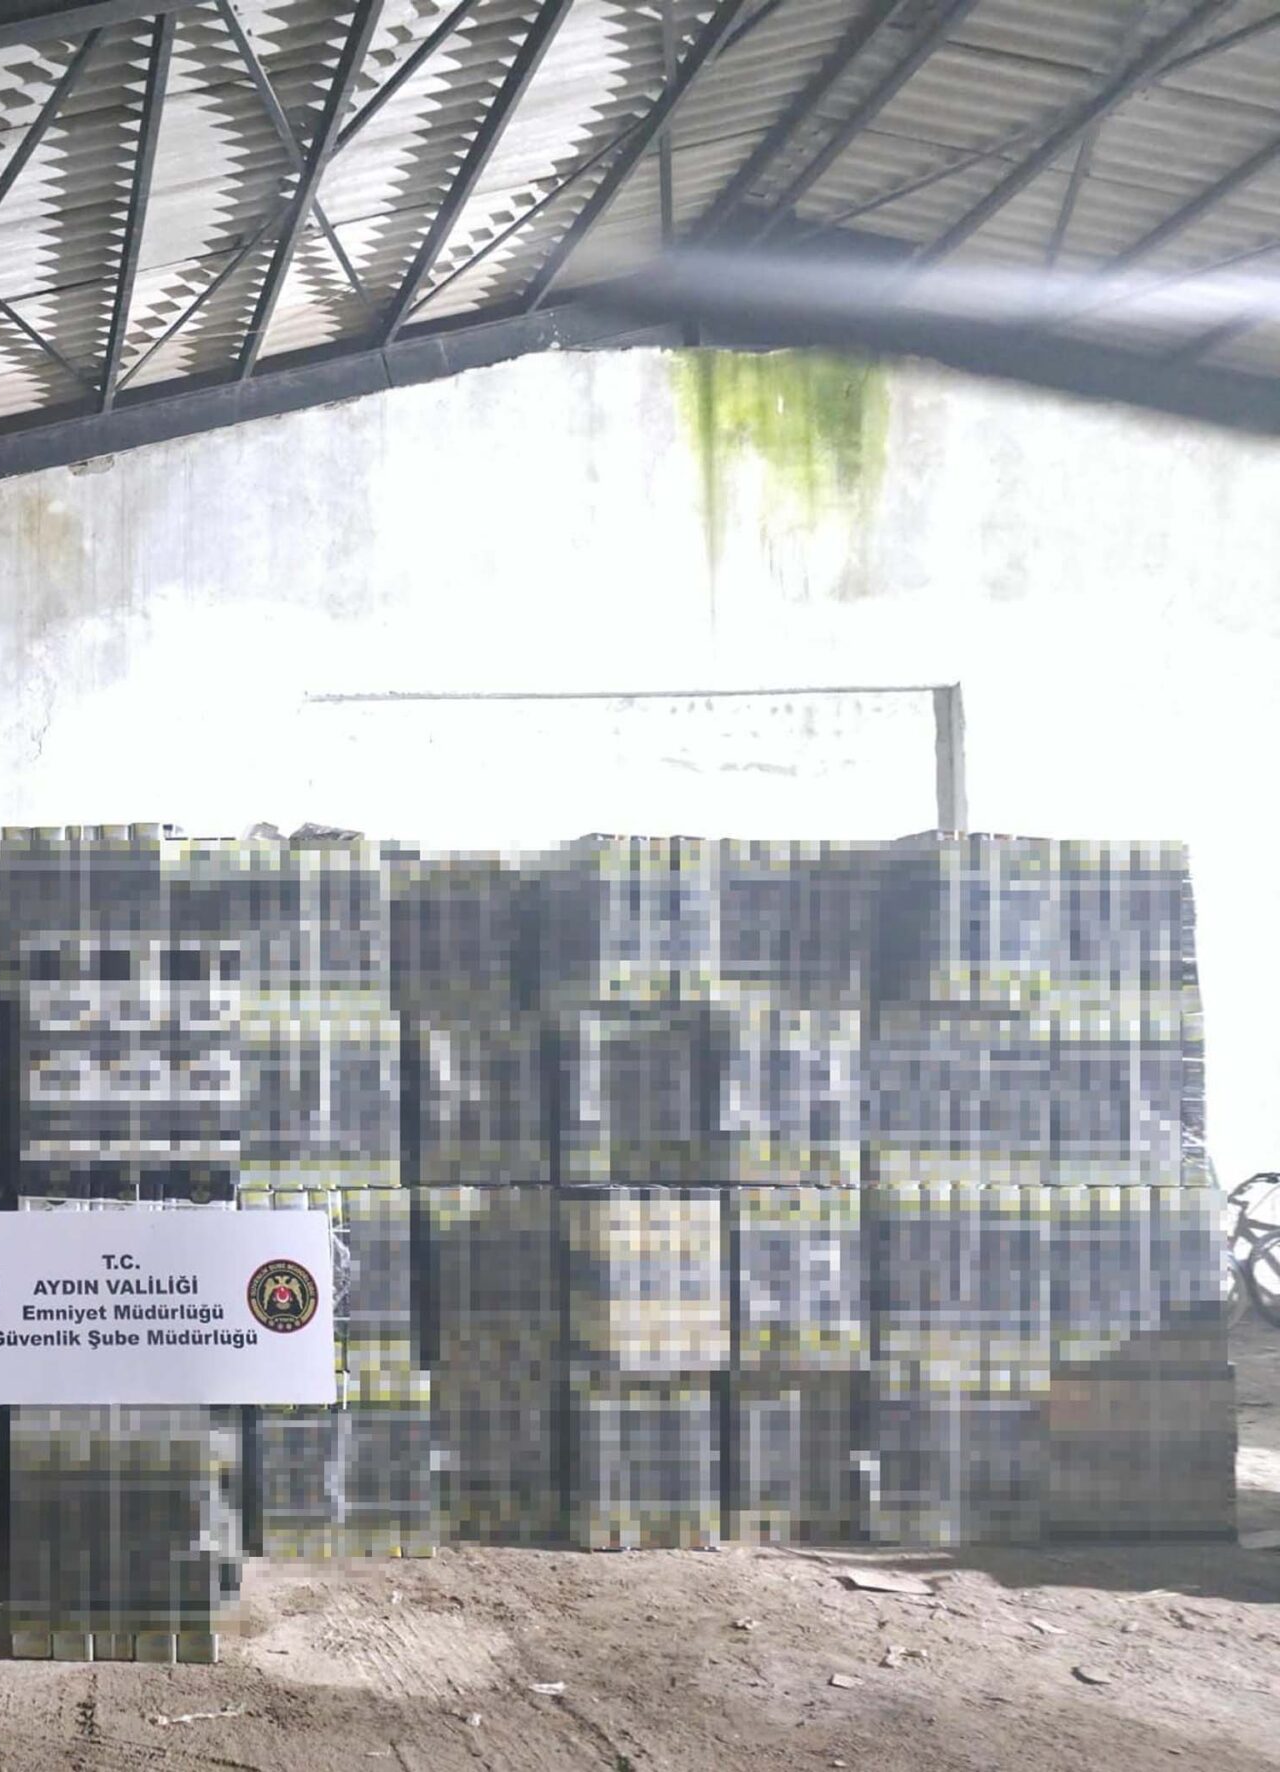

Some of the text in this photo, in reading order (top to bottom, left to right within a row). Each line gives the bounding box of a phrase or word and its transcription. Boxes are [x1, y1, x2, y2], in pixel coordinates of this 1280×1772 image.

[102, 1254, 141, 1270] T.C.
[34, 1275, 198, 1296] AYDIN VALİLİĞİ
[23, 1304, 224, 1325] Emniyet Müdürlüğü
[88, 1330, 140, 1351] Şube
[147, 1330, 258, 1349] Müdürlüğü
